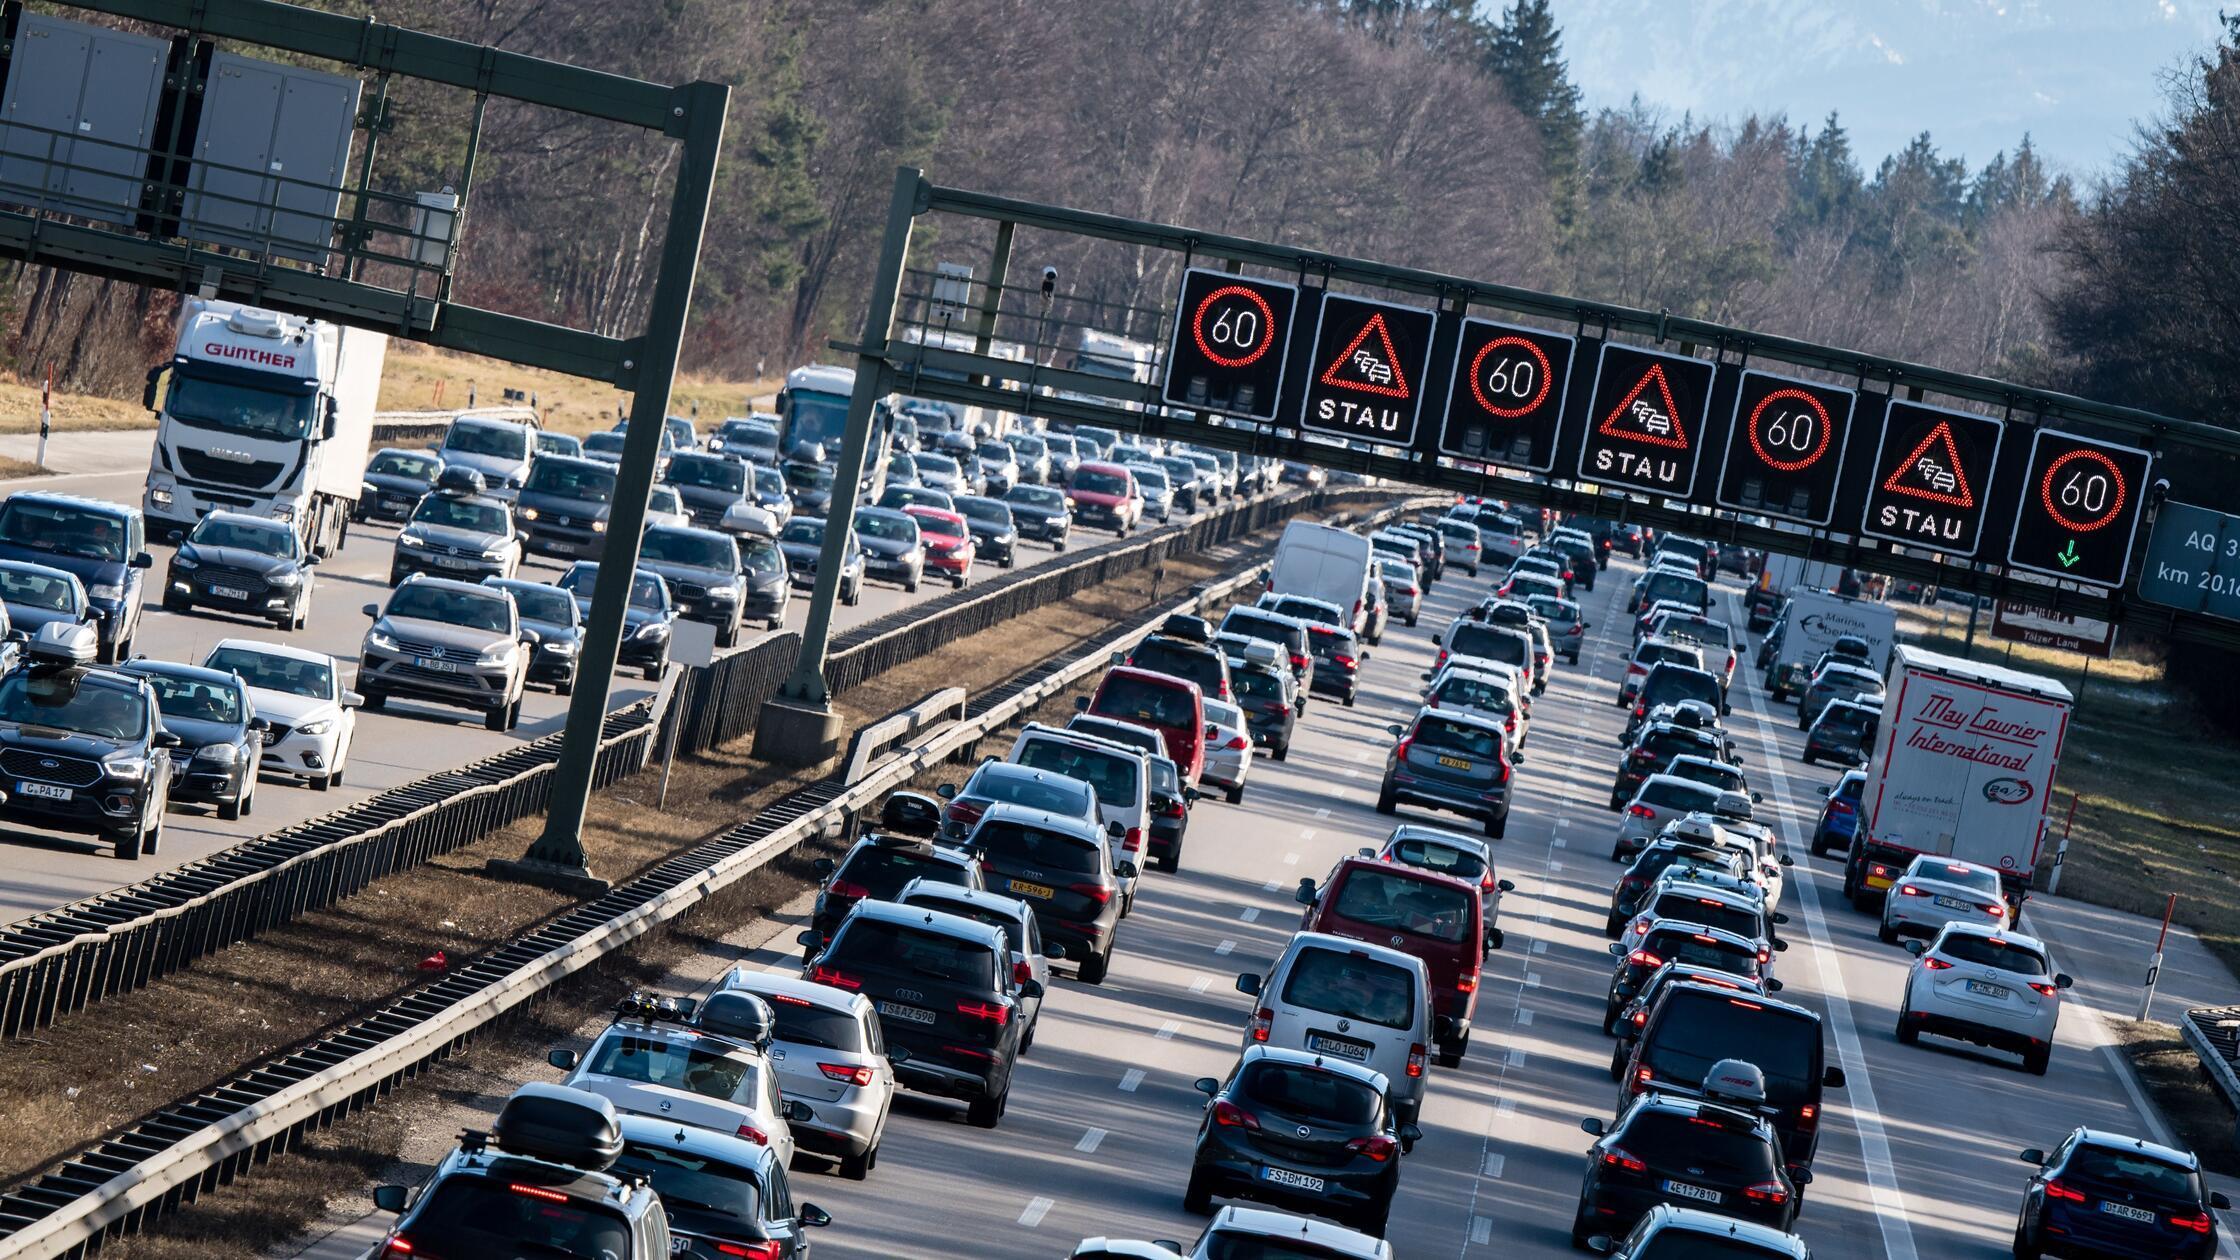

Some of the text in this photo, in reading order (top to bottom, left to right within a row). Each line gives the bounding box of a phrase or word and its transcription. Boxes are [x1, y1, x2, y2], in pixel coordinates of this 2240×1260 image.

[1212, 307, 1257, 348] 60
[1489, 357, 1533, 398] 60
[1318, 399, 1399, 431] STAU
[1768, 410, 1812, 451] 60
[1596, 448, 1677, 482] STAU
[2061, 471, 2107, 512] 60
[1880, 505, 1962, 540] STAU
[2184, 530, 2216, 552] AQ
[2157, 561, 2189, 585] km
[1825, 612, 1866, 629] Marinus
[2023, 631, 2080, 649] Tölzer Land
[1913, 694, 2047, 742] May Courier
[1905, 726, 2034, 772] International
[1893, 791, 1921, 804] always
[1990, 785, 2027, 798] 24/7
